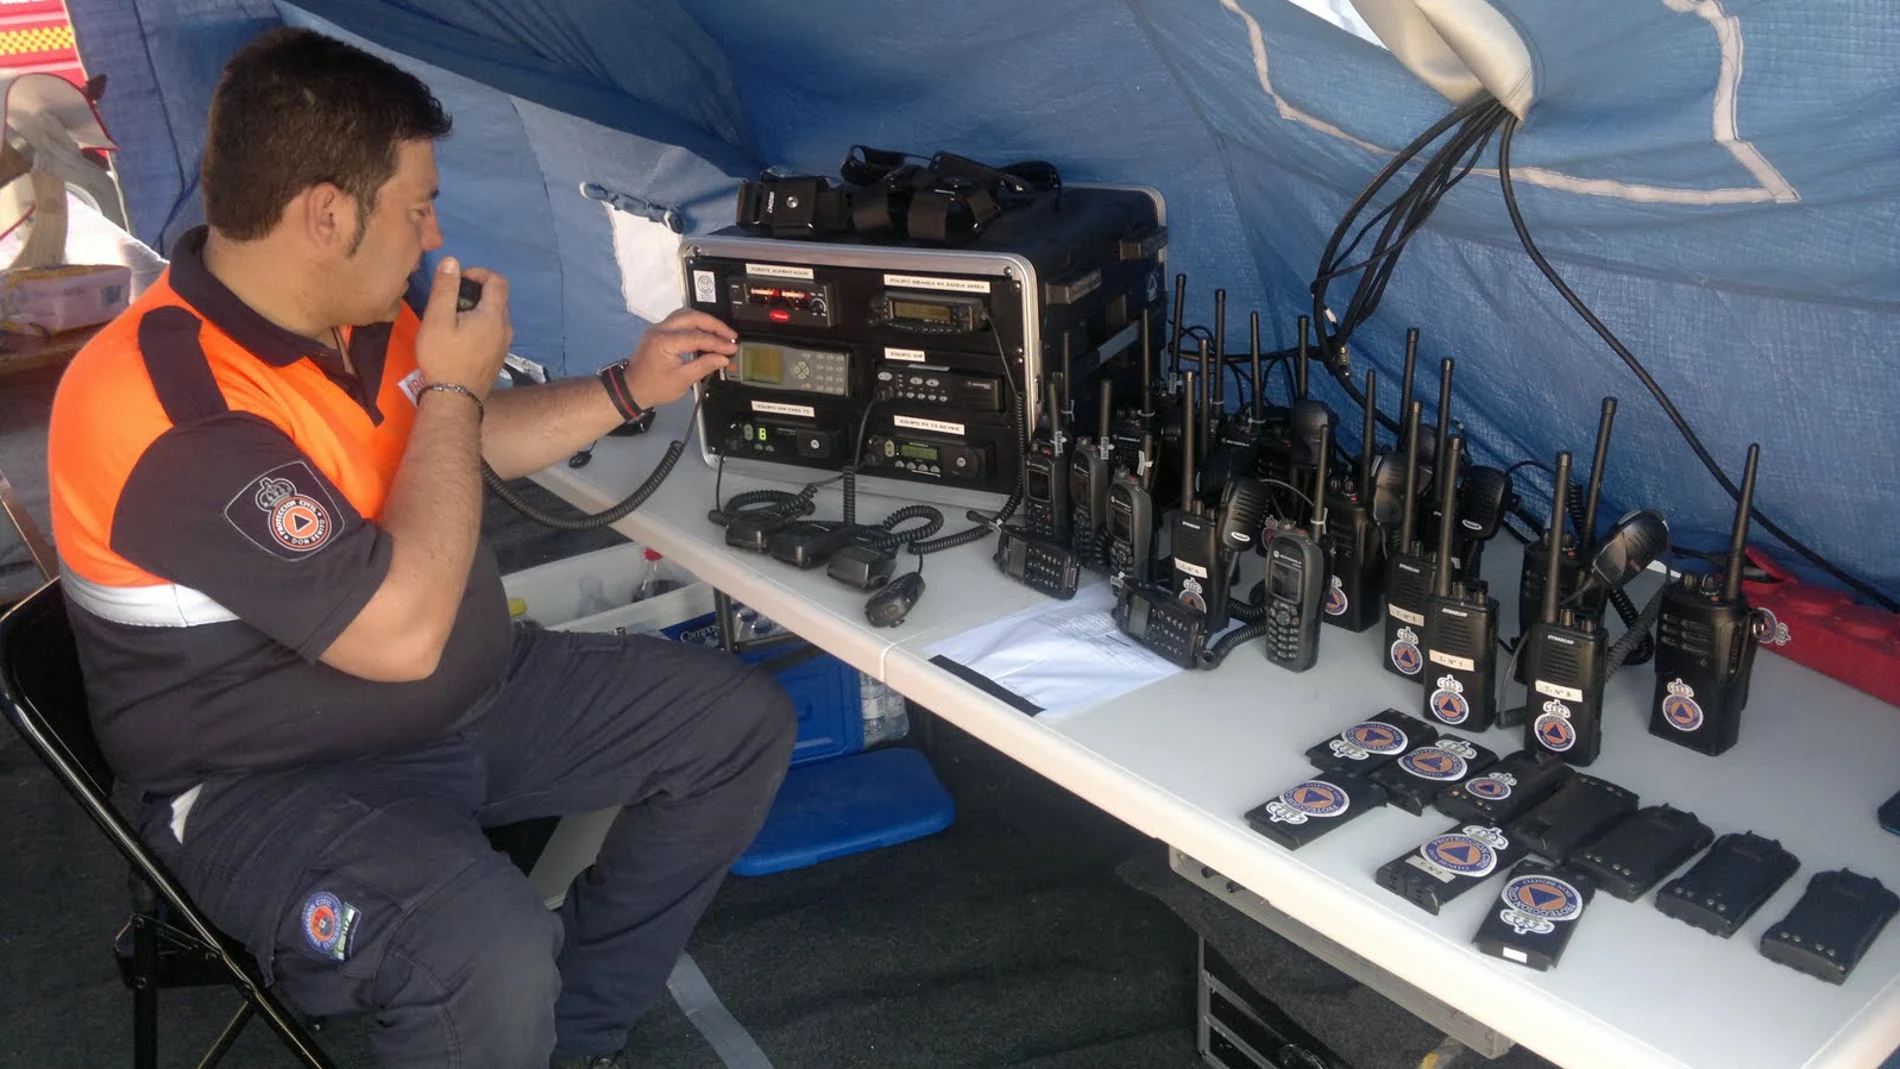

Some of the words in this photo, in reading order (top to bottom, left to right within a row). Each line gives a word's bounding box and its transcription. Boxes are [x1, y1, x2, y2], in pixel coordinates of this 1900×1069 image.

[299, 500, 317, 512] CIVIL
[1433, 836, 1488, 854] PROTECCION
[1476, 854, 1490, 868] CIVIL
[1514, 901, 1575, 917] PROTECCION
